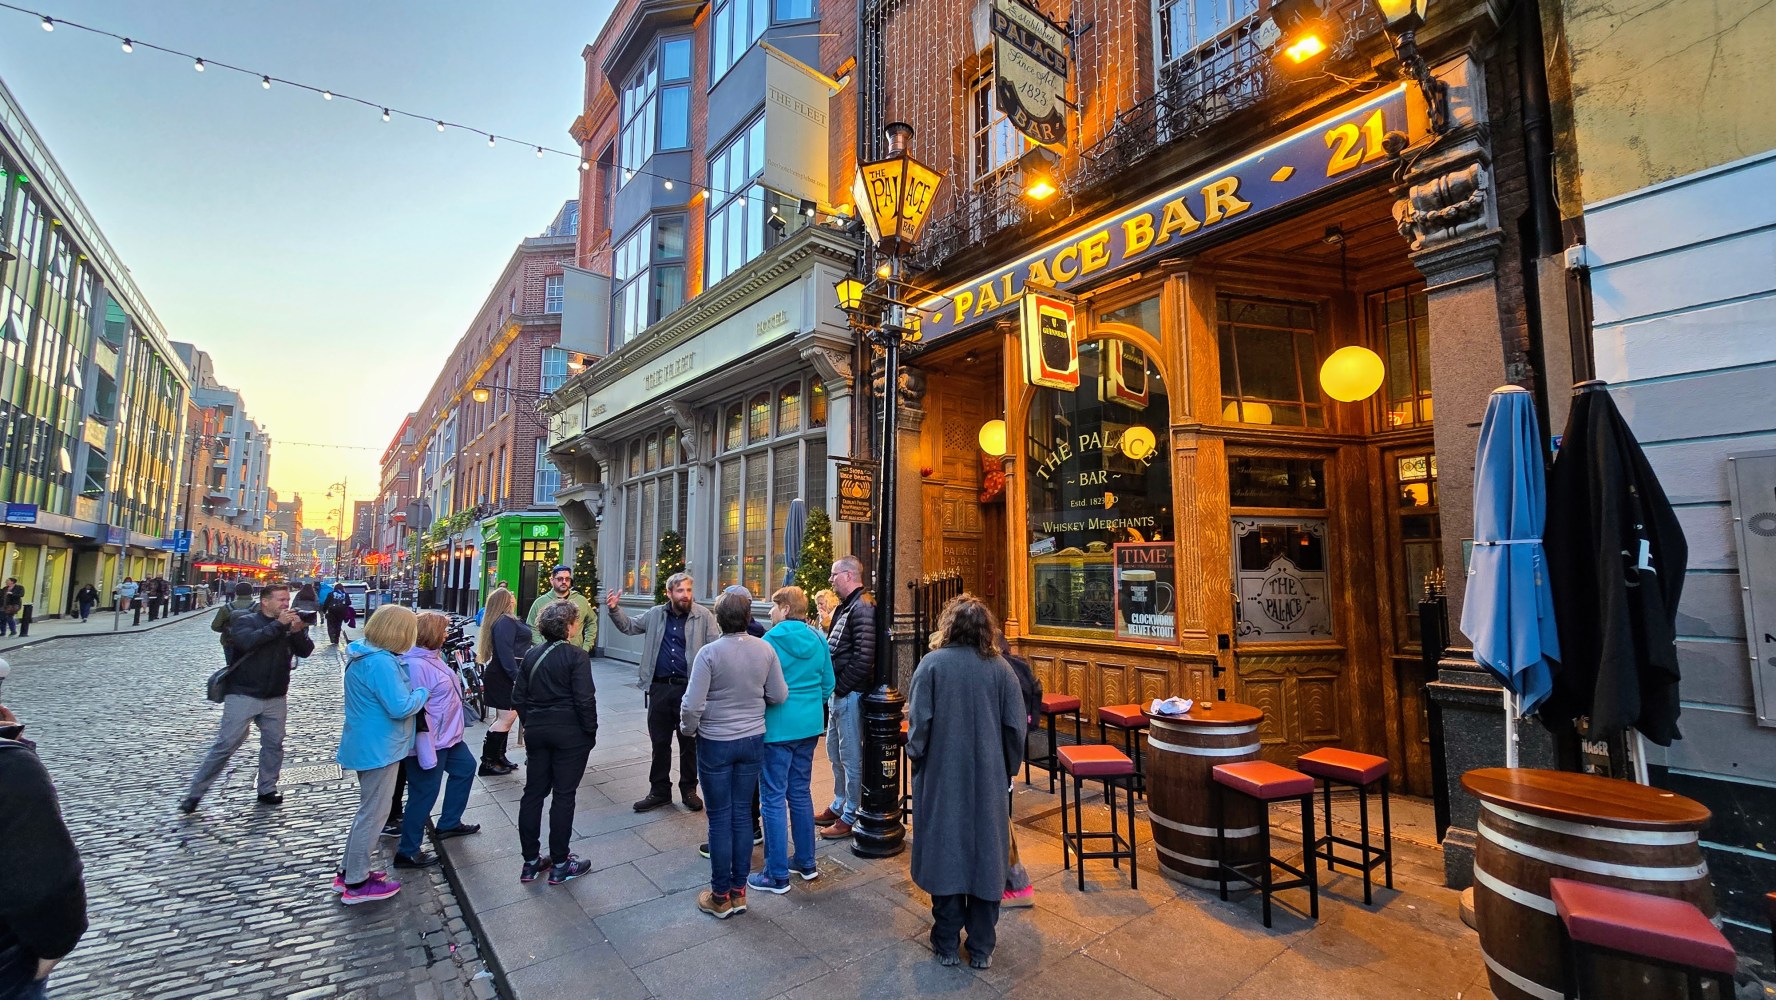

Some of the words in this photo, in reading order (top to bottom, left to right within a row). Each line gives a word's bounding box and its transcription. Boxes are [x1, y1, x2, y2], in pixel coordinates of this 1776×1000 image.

[1005, 4, 1055, 44] Established
[995, 13, 1065, 74] PALACE
[1008, 48, 1035, 76] Since
[769, 88, 791, 107] THE
[794, 102, 827, 124] FLEET
[1019, 81, 1047, 107] 1823
[1015, 107, 1055, 140] BAR
[1326, 108, 1387, 178] 21
[869, 169, 886, 178] THE
[871, 175, 930, 220] PALACE
[902, 222, 915, 235] BAR
[953, 230, 1112, 326] PALACE
[1122, 176, 1251, 259] BAR
[663, 352, 696, 382] FLEET
[1036, 443, 1073, 480] THE
[1079, 430, 1159, 467] PALACE
[1079, 470, 1108, 486] BAR
[1070, 499, 1087, 508] Estd.
[1090, 496, 1105, 506] 1823
[944, 547, 977, 556] PALACE
[950, 557, 970, 566] BAR
[1121, 548, 1168, 564] TIME
[1269, 577, 1298, 596] THE
[1131, 613, 1174, 626] CLOCKWORK
[1265, 598, 1303, 622] PALACE
[1128, 624, 1151, 636] VELVET
[1152, 627, 1174, 638] STOUT
